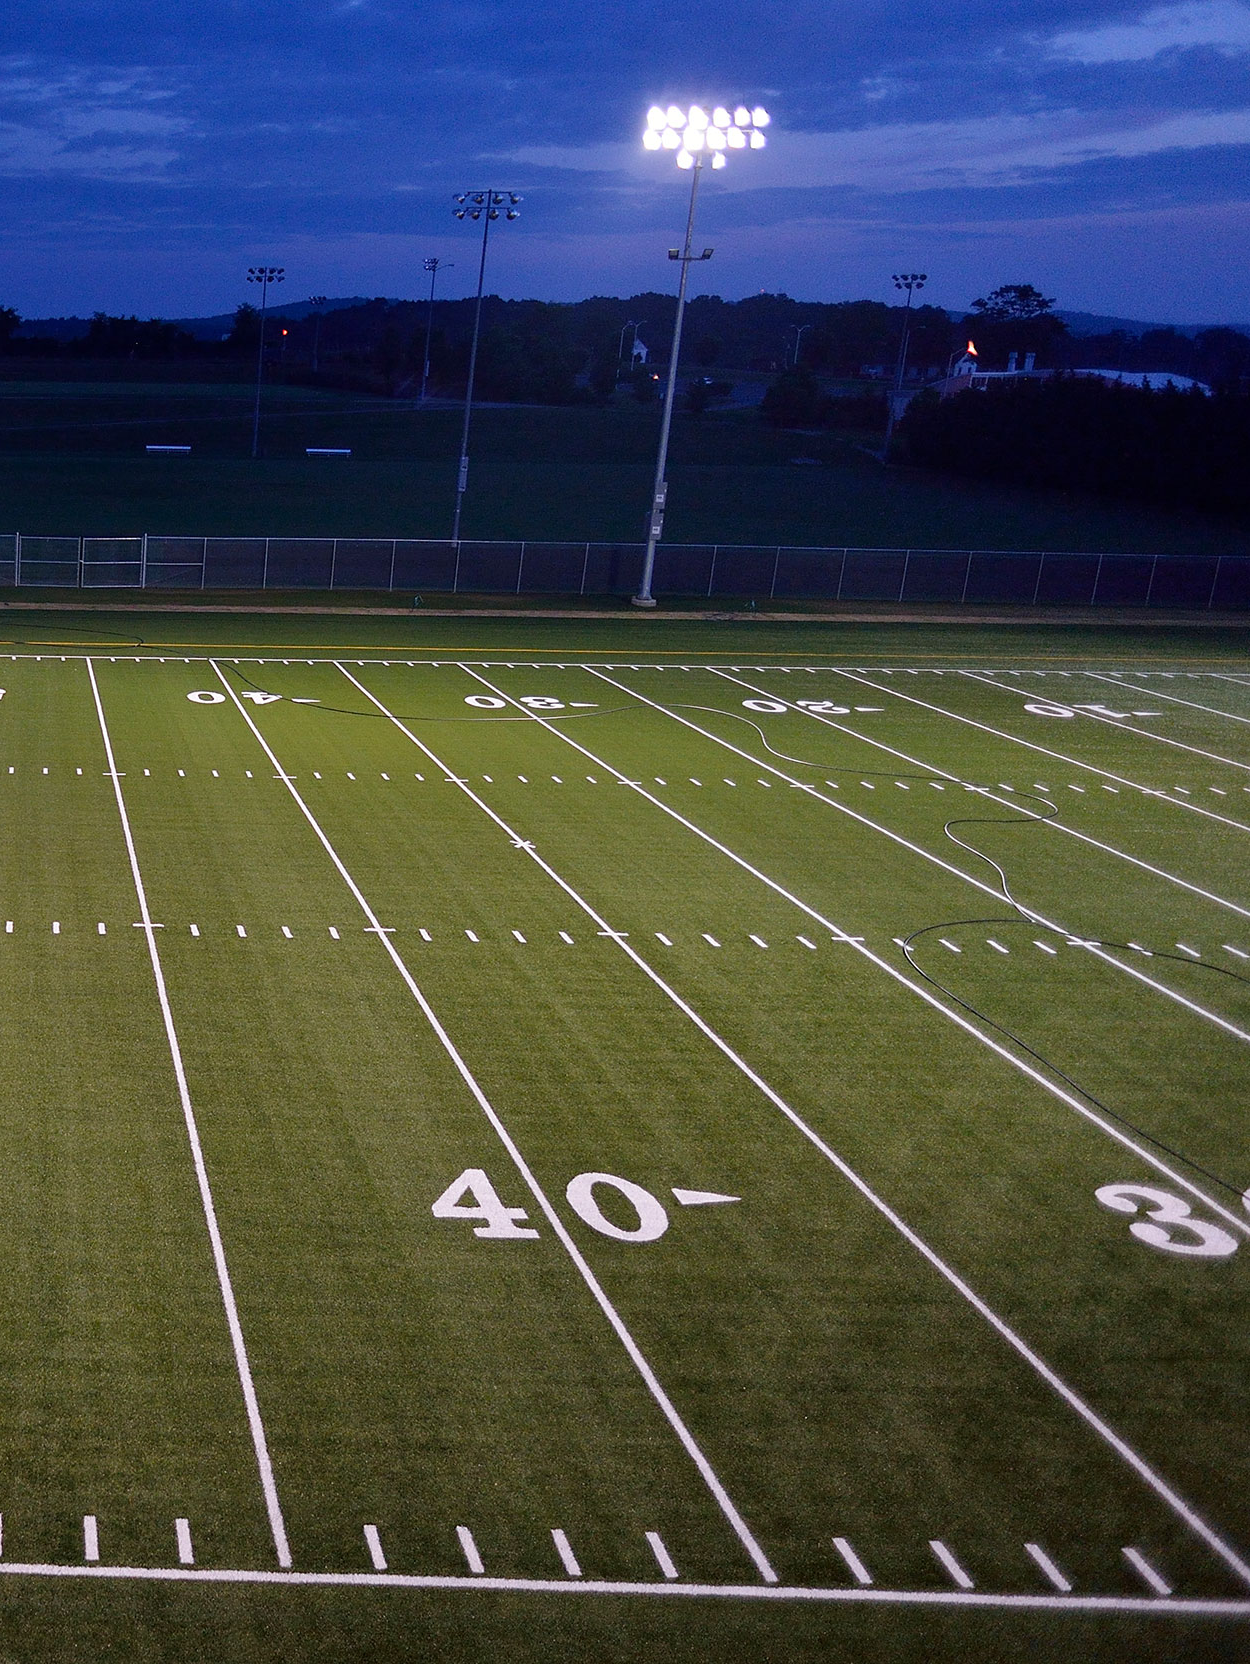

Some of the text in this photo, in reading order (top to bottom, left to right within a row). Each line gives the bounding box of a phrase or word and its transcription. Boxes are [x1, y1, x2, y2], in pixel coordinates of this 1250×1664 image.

[186, 690, 283, 705] 40
[464, 695, 566, 710] 30
[741, 699, 851, 715] 20
[431, 1168, 669, 1242] 40
[1094, 1184, 1250, 1256] 3
